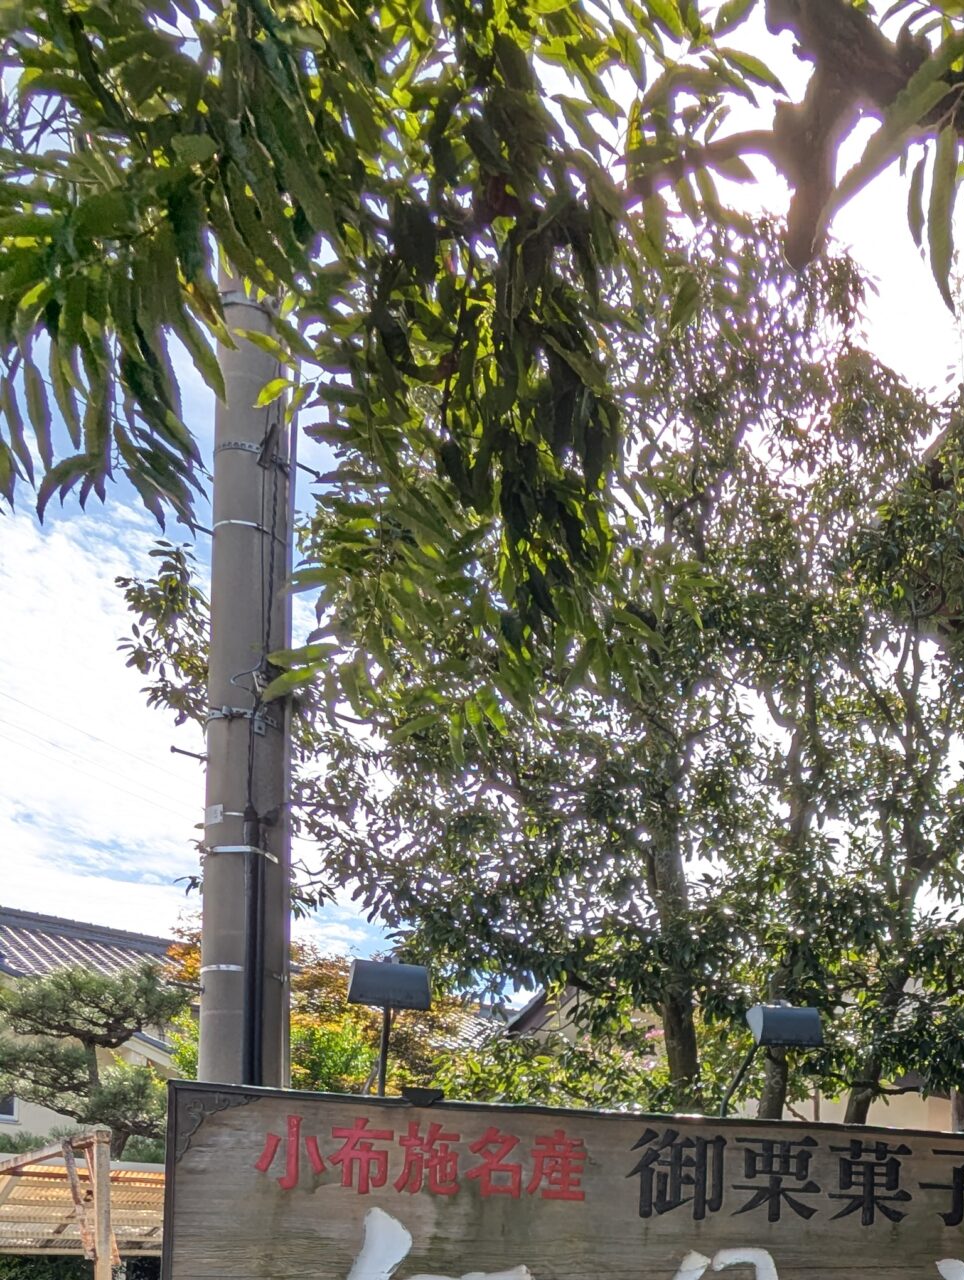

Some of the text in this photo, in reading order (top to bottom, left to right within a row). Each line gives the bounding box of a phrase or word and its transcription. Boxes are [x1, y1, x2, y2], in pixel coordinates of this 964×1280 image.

[254, 1114, 587, 1201] 小布施名産
